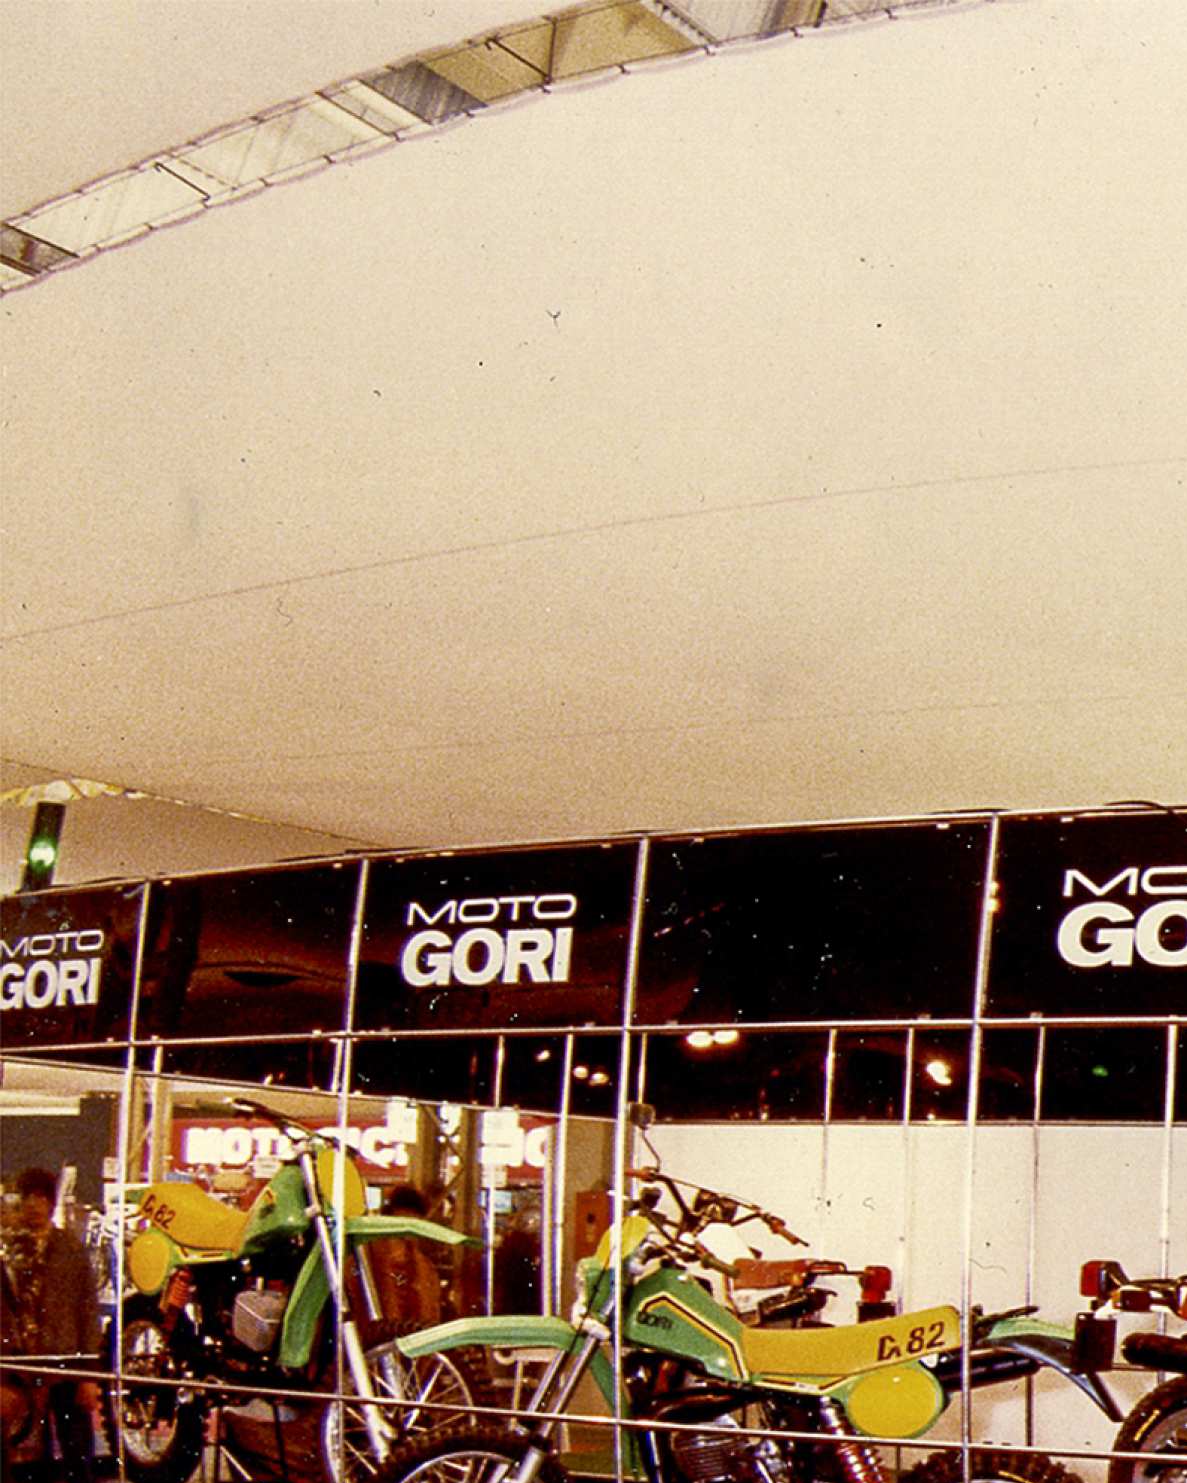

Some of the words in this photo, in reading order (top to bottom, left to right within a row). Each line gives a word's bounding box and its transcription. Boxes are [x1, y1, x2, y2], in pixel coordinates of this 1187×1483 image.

[406, 894, 577, 926] MOTO
[0, 929, 105, 958] MOTO
[401, 927, 574, 987] GORI
[0, 957, 102, 1010] GORI
